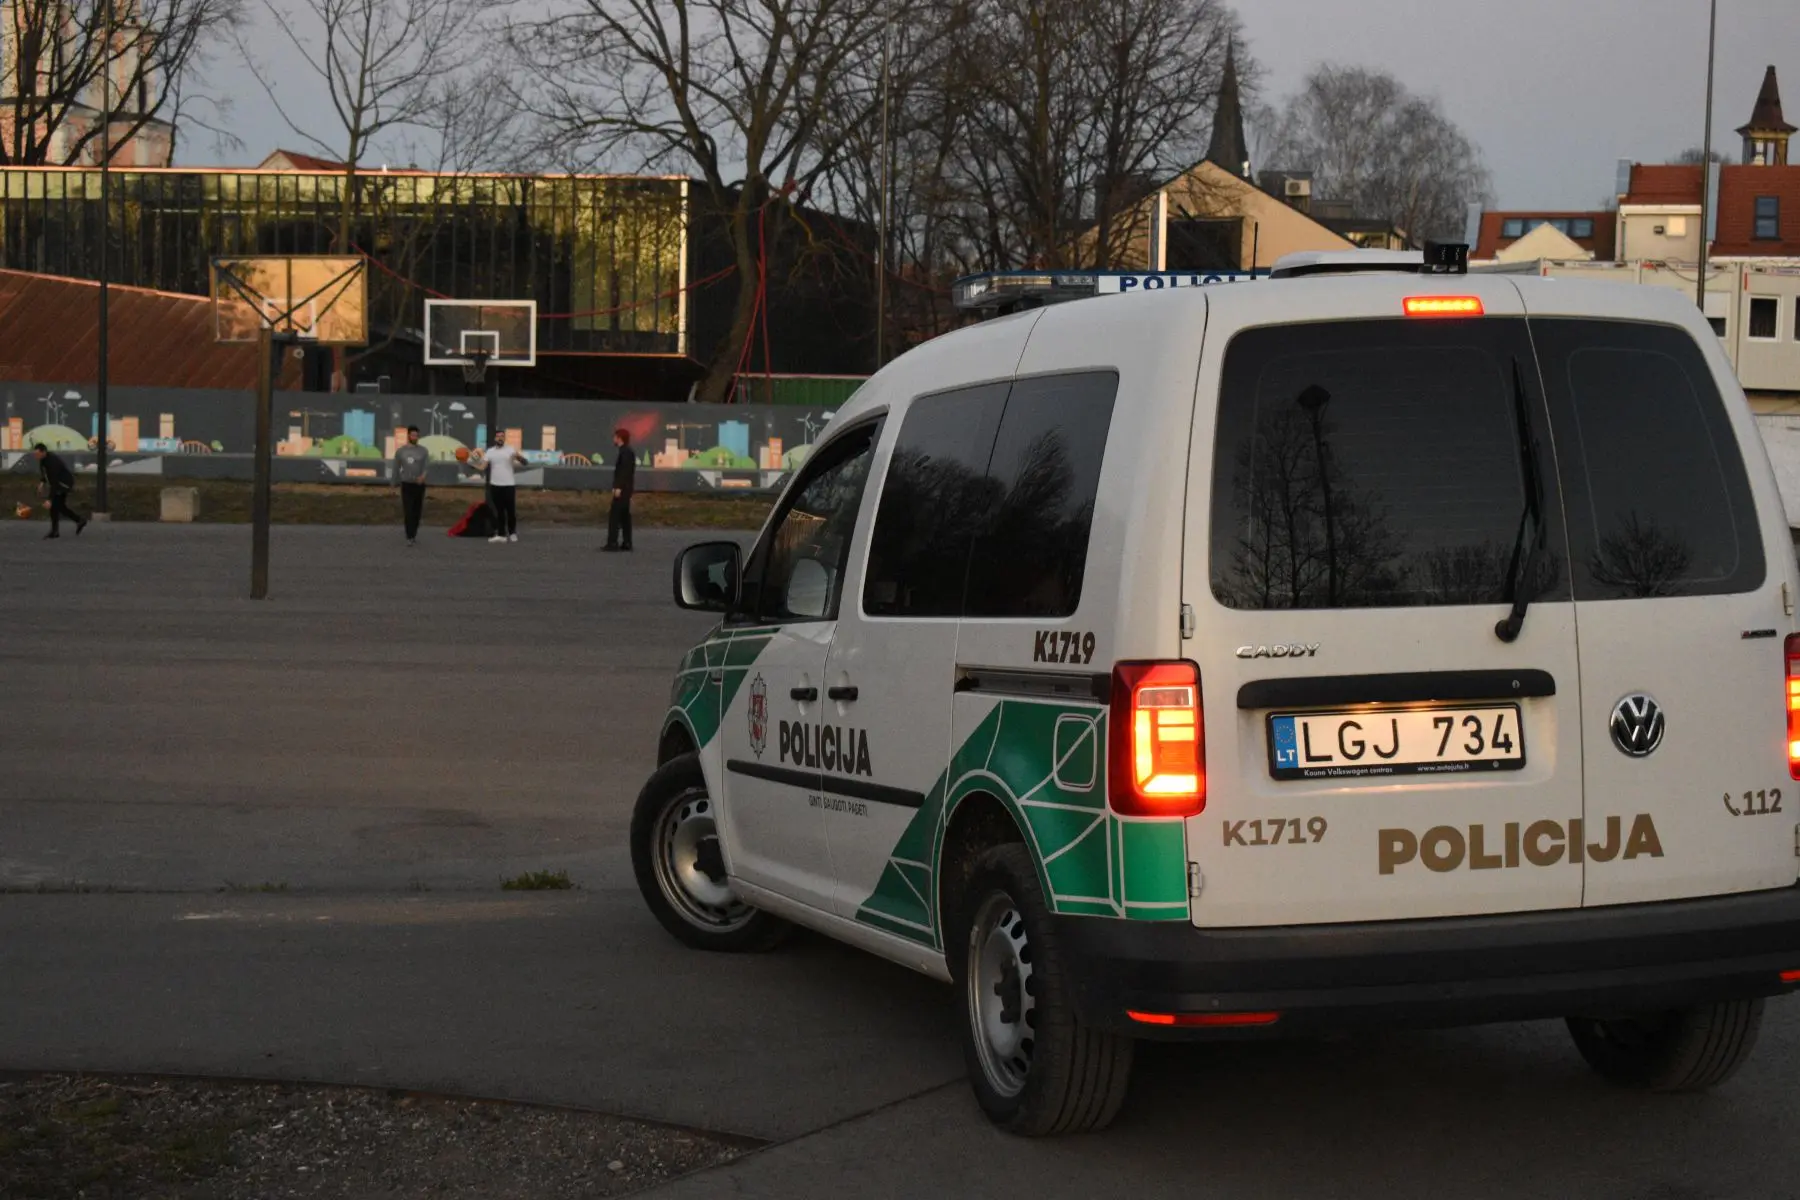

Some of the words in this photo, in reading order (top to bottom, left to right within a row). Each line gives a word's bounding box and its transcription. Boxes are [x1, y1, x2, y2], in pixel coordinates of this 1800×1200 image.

[1034, 631, 1096, 665] K1719
[1236, 642, 1320, 659] CADDY
[779, 720, 873, 776] POLICIJA
[1303, 718, 1400, 762] LGJ
[1432, 713, 1513, 757] 734
[1277, 749, 1296, 762] LT
[1327, 767, 1369, 776] Volkswagen
[1369, 766, 1393, 774] centras
[1743, 788, 1783, 816] 112
[1222, 816, 1328, 847] K1719
[1378, 813, 1665, 876] POLICIJA
